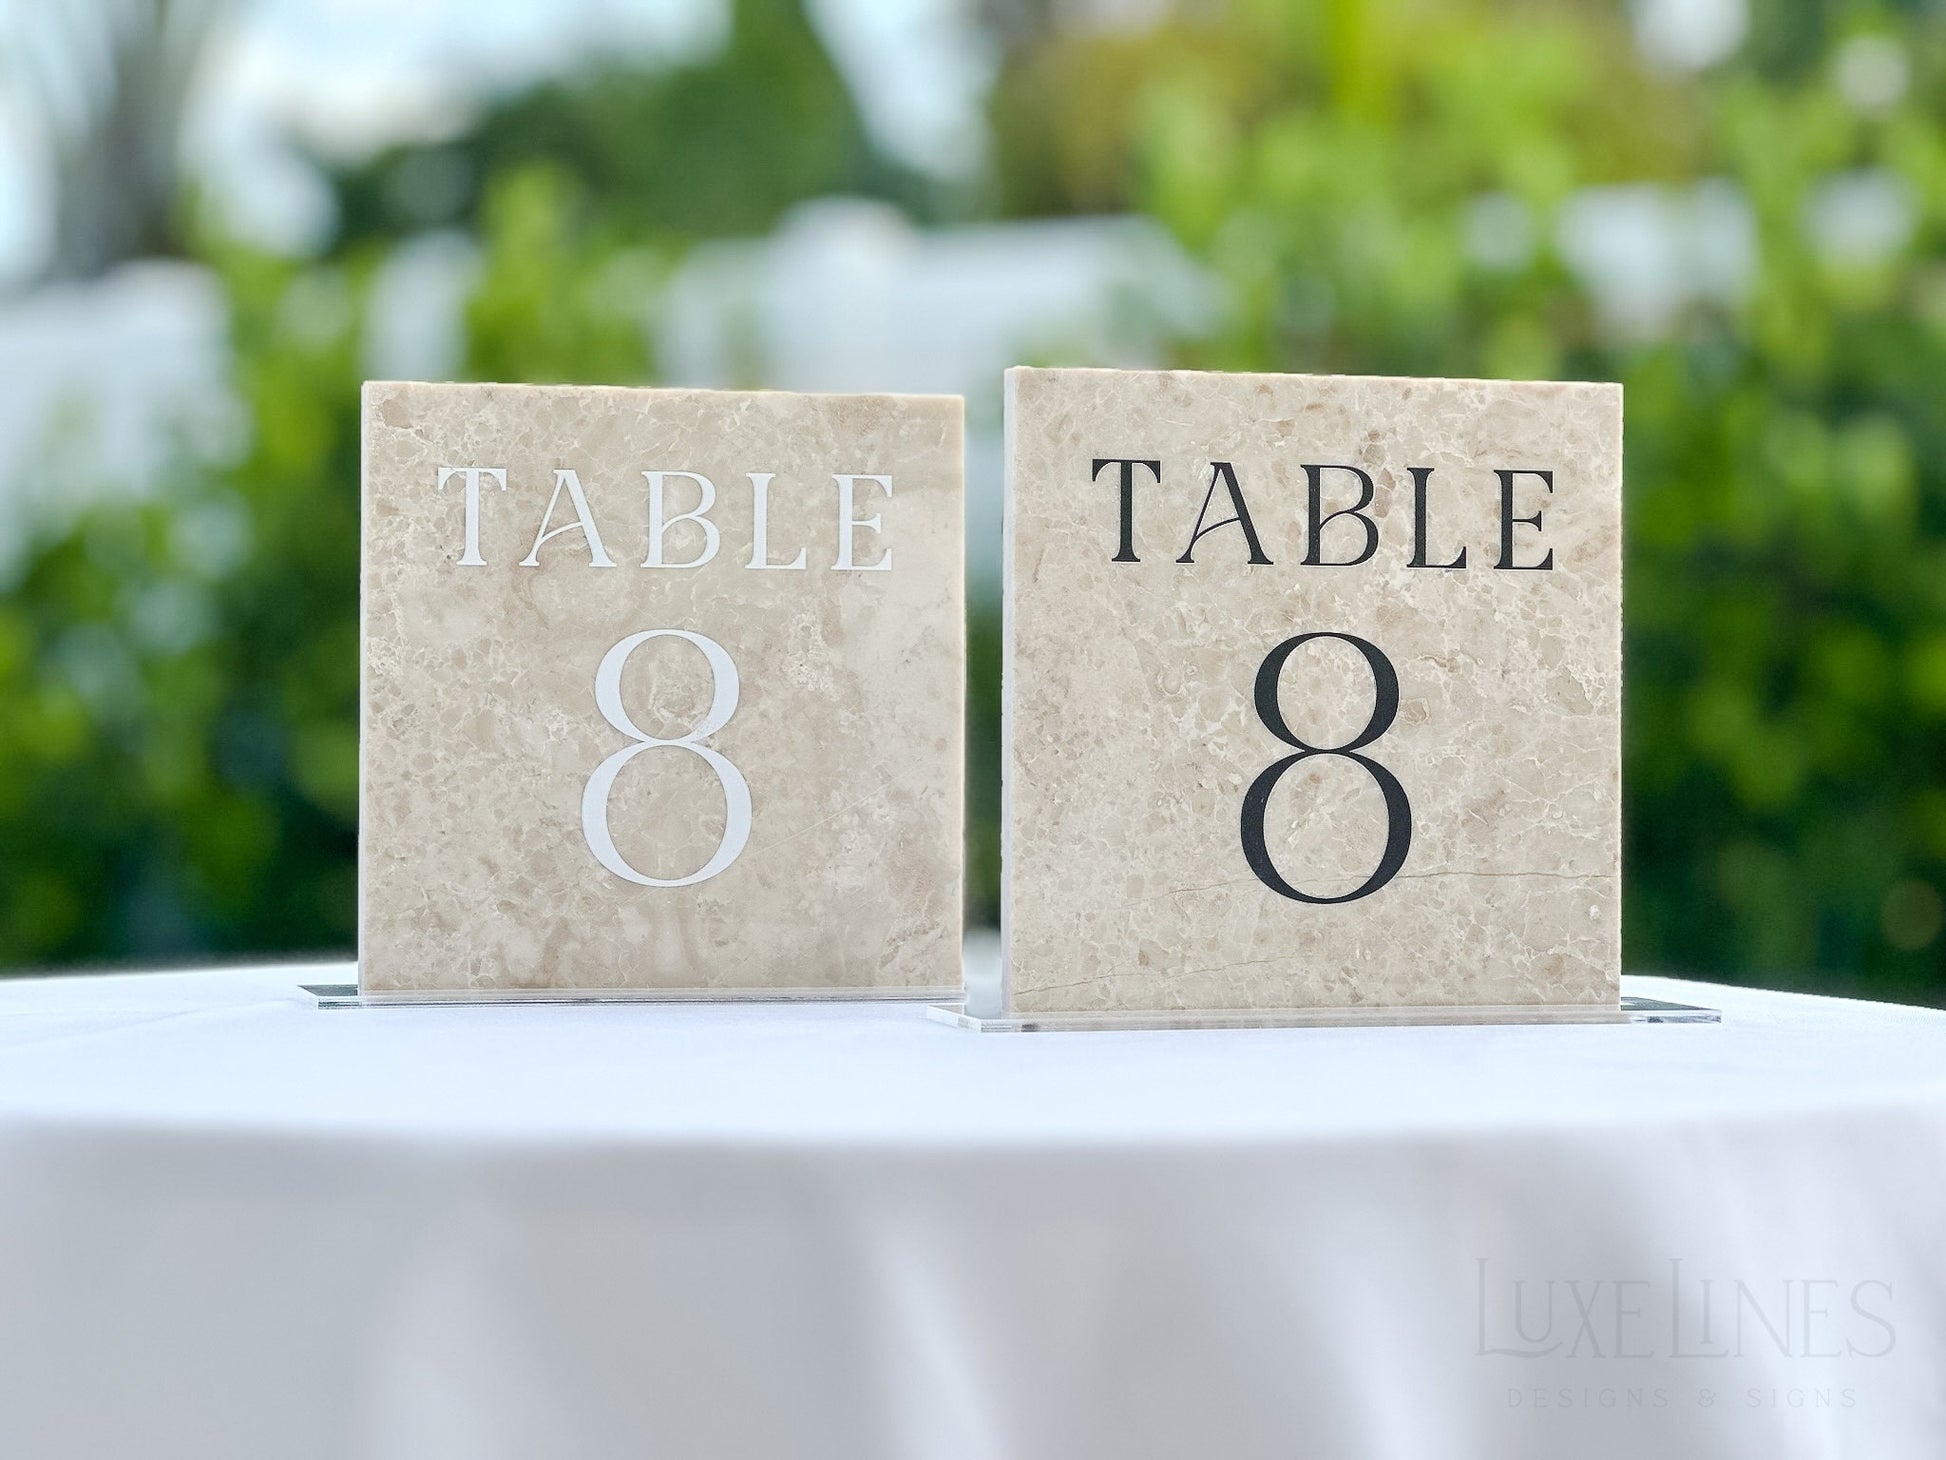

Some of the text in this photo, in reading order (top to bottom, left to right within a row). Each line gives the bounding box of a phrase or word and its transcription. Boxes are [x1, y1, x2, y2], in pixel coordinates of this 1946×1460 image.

[437, 467, 894, 572] TABLE
[1091, 458, 1554, 571] TABLE
[581, 628, 753, 888] 8
[1240, 631, 1412, 904] 8
